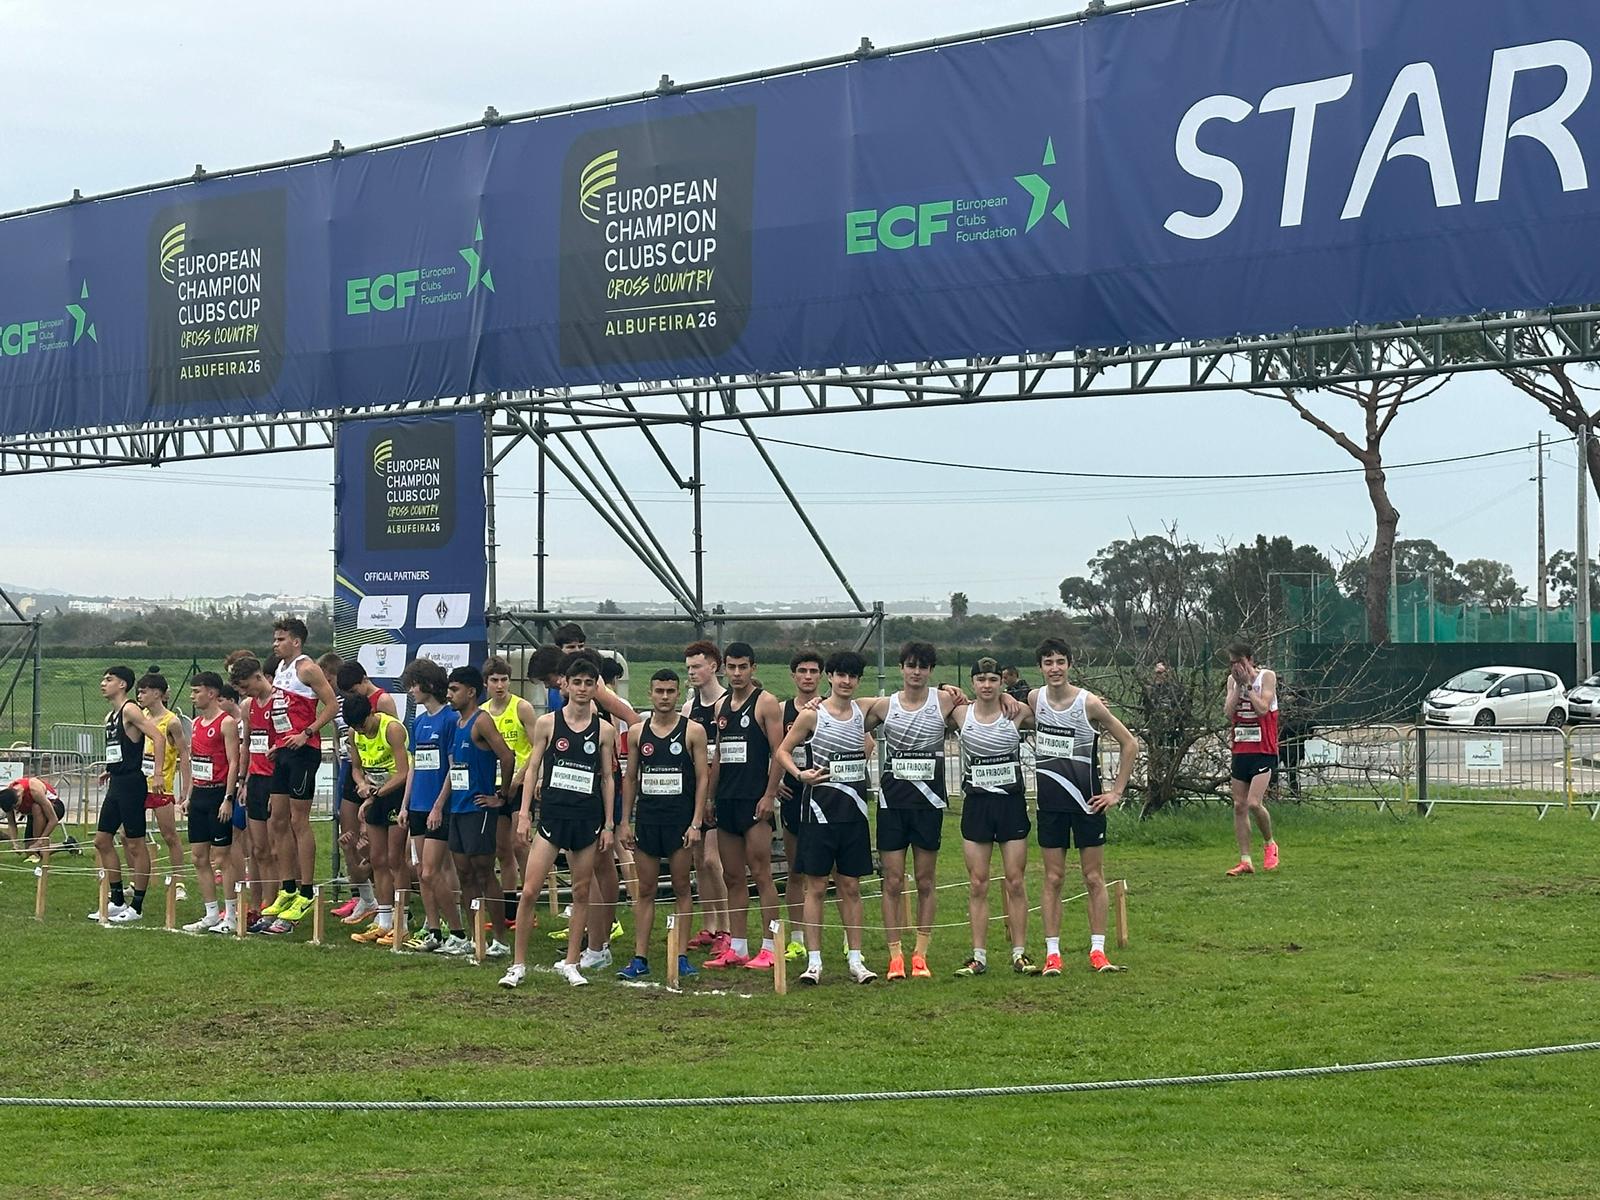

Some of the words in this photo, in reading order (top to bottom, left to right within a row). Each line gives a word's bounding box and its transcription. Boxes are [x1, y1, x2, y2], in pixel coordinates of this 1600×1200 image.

[1163, 39, 1593, 240] STAR
[606, 177, 718, 216] EUROPEAN
[956, 196, 1008, 212] European
[605, 207, 717, 244] CHAMPION
[846, 199, 954, 255] ECF
[956, 213, 987, 227] Clubs
[956, 226, 1017, 243] Foundation
[178, 247, 261, 277] EUROPEAN
[604, 242, 667, 273] CLUBS
[671, 237, 717, 266] CUP
[421, 265, 456, 280] European
[178, 272, 261, 301] CHAMPION
[421, 281, 442, 292] Clubs
[607, 275, 650, 300] CROSS
[653, 266, 716, 295] COUNTRY
[347, 269, 420, 315] ECF
[421, 291, 462, 305] Foundation
[178, 301, 226, 326] CLUBS
[228, 297, 261, 320] CUP
[40, 320, 64, 330] European
[605, 311, 717, 337] ALBUFEIRA26
[0, 321, 39, 356] CF
[40, 332, 55, 340] Clubs
[181, 328, 211, 349] CROSS
[214, 323, 260, 345] COUNTRY
[40, 341, 69, 351] Foundation
[180, 359, 261, 380] ALBUFEIRA26
[386, 457, 440, 473] EUROPEAN
[386, 472, 440, 488] CHAMPION
[386, 489, 418, 503] CLUBS
[419, 488, 440, 501] CUP
[387, 505, 409, 517] CROSS
[410, 503, 439, 516] COUNTRY
[386, 522, 440, 534] ALBUFEIRA26
[364, 571, 393, 582] OFFICIAL
[394, 570, 430, 580] PARTNERS
[907, 762, 932, 771] FRIBOURG
[986, 766, 1011, 777] FRIBOURG
